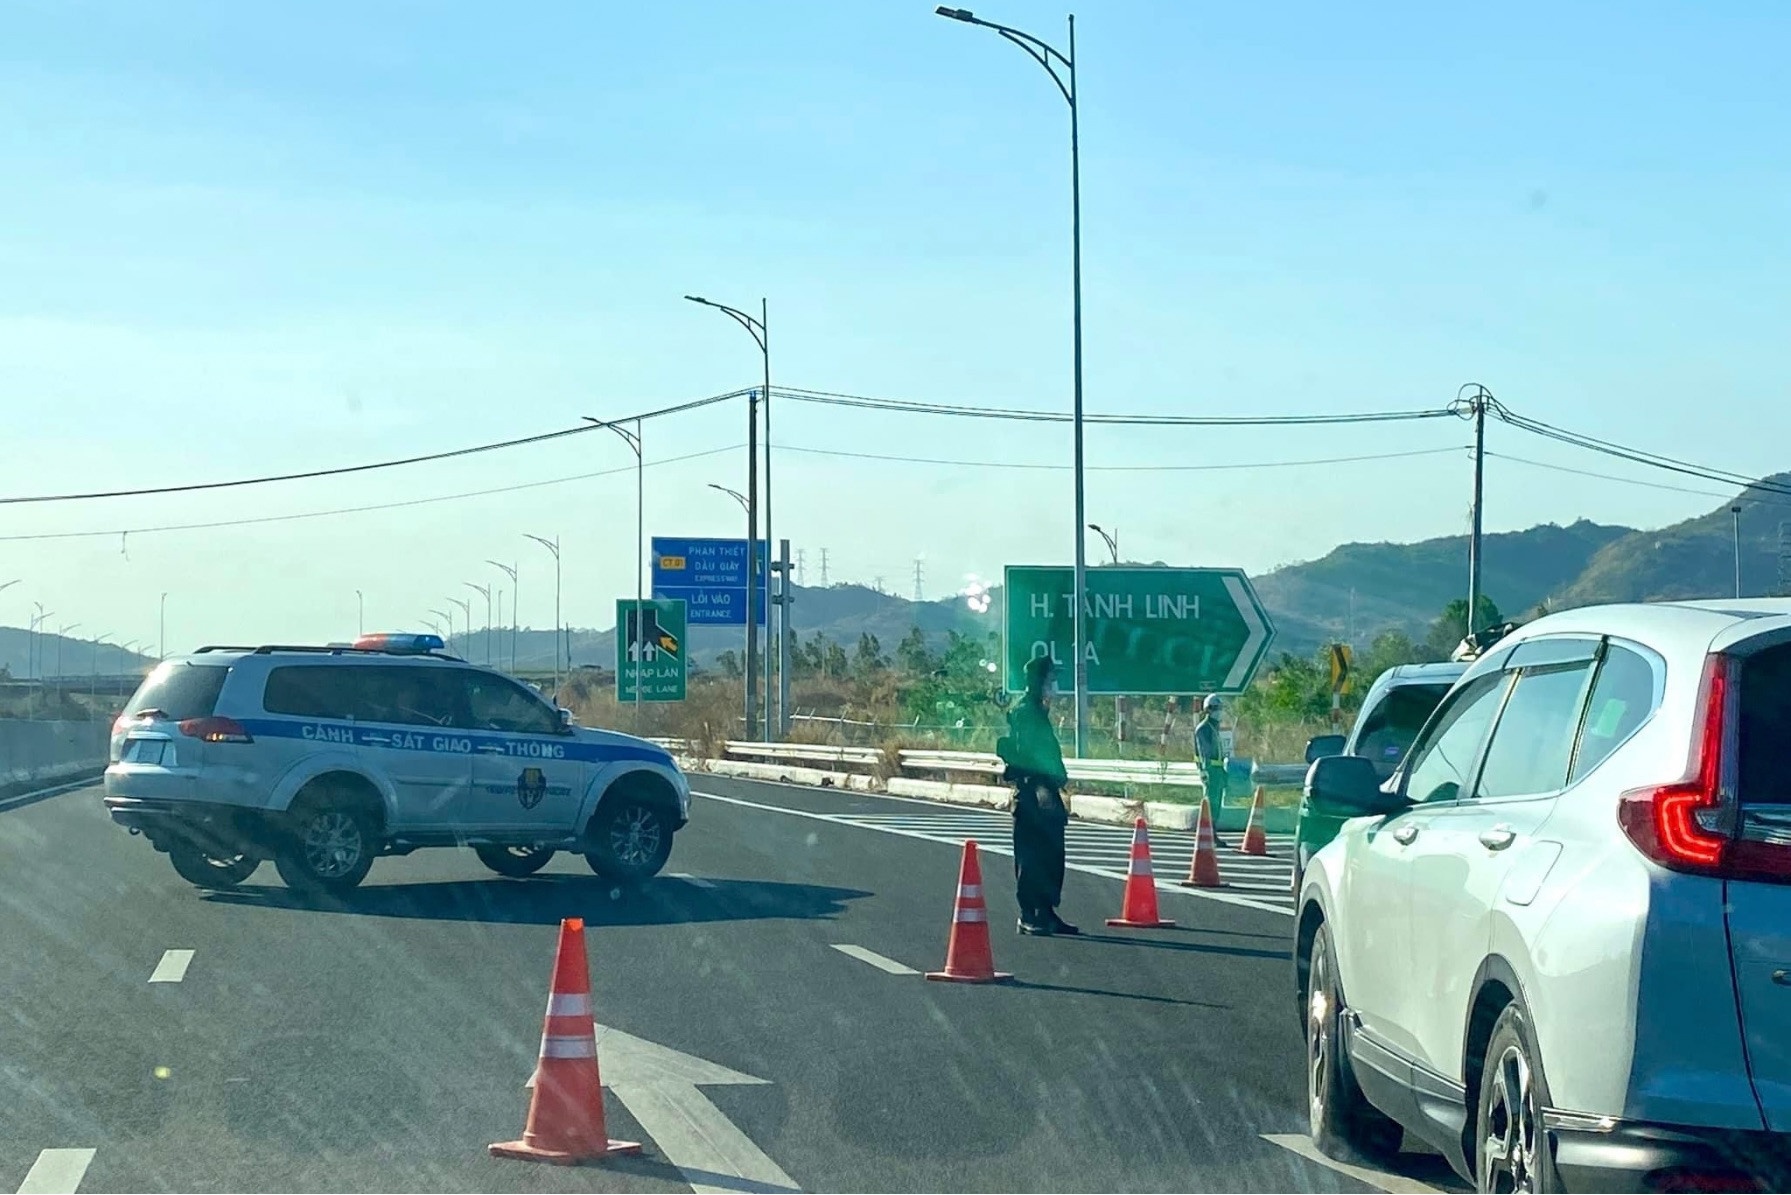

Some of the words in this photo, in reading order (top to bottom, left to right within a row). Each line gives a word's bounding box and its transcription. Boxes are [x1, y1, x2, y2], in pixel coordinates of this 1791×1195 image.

[688, 546, 716, 556] PHAN
[711, 591, 731, 605] VÀO
[1031, 593, 1054, 618] H.
[1146, 594, 1200, 619] LINH
[690, 609, 732, 618] ENTRANCE
[625, 685, 653, 693] MEGE
[656, 685, 678, 693] LANE
[302, 723, 354, 742] CẢNH
[391, 731, 425, 749] SÁT
[432, 736, 472, 753] GIAO
[506, 741, 565, 758] THÔNG
